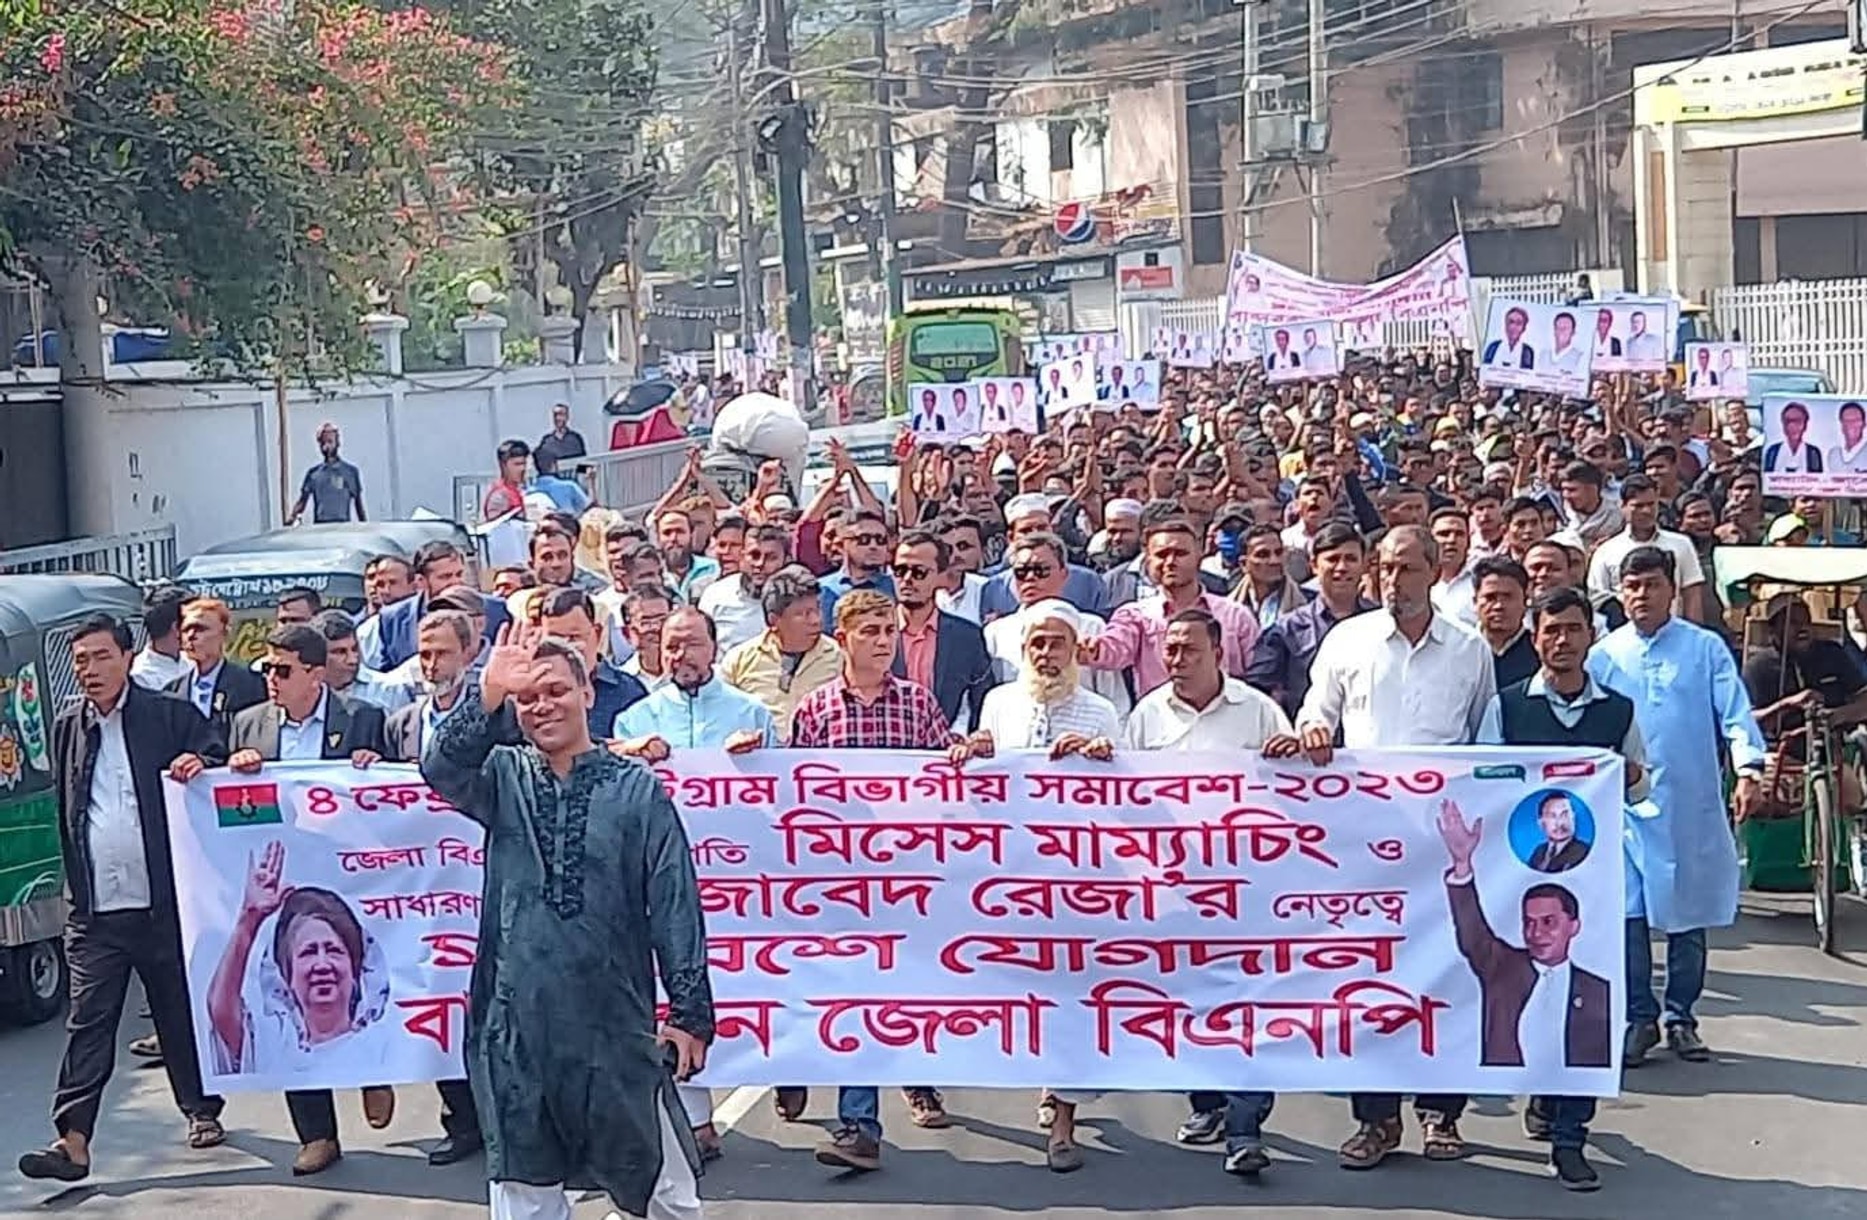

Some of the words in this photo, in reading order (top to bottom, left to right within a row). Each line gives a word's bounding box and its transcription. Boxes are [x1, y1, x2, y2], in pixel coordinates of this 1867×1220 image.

[307, 786, 339, 815] ৪
[791, 763, 1007, 806] বিভাগীয়
[1025, 769, 1446, 807] সমাবেশ-২০২৩
[337, 846, 427, 872] জেলা
[770, 807, 1013, 866] মিসেস
[1367, 839, 1403, 860] ও
[359, 889, 482, 920] সাধারণ
[695, 873, 945, 919] জাবেদ
[1272, 890, 1409, 928] নেতৃত্বে
[938, 935, 1406, 975] যোগদান
[803, 993, 1058, 1056] জেলা
[1082, 978, 1451, 1059] বিএনপি
